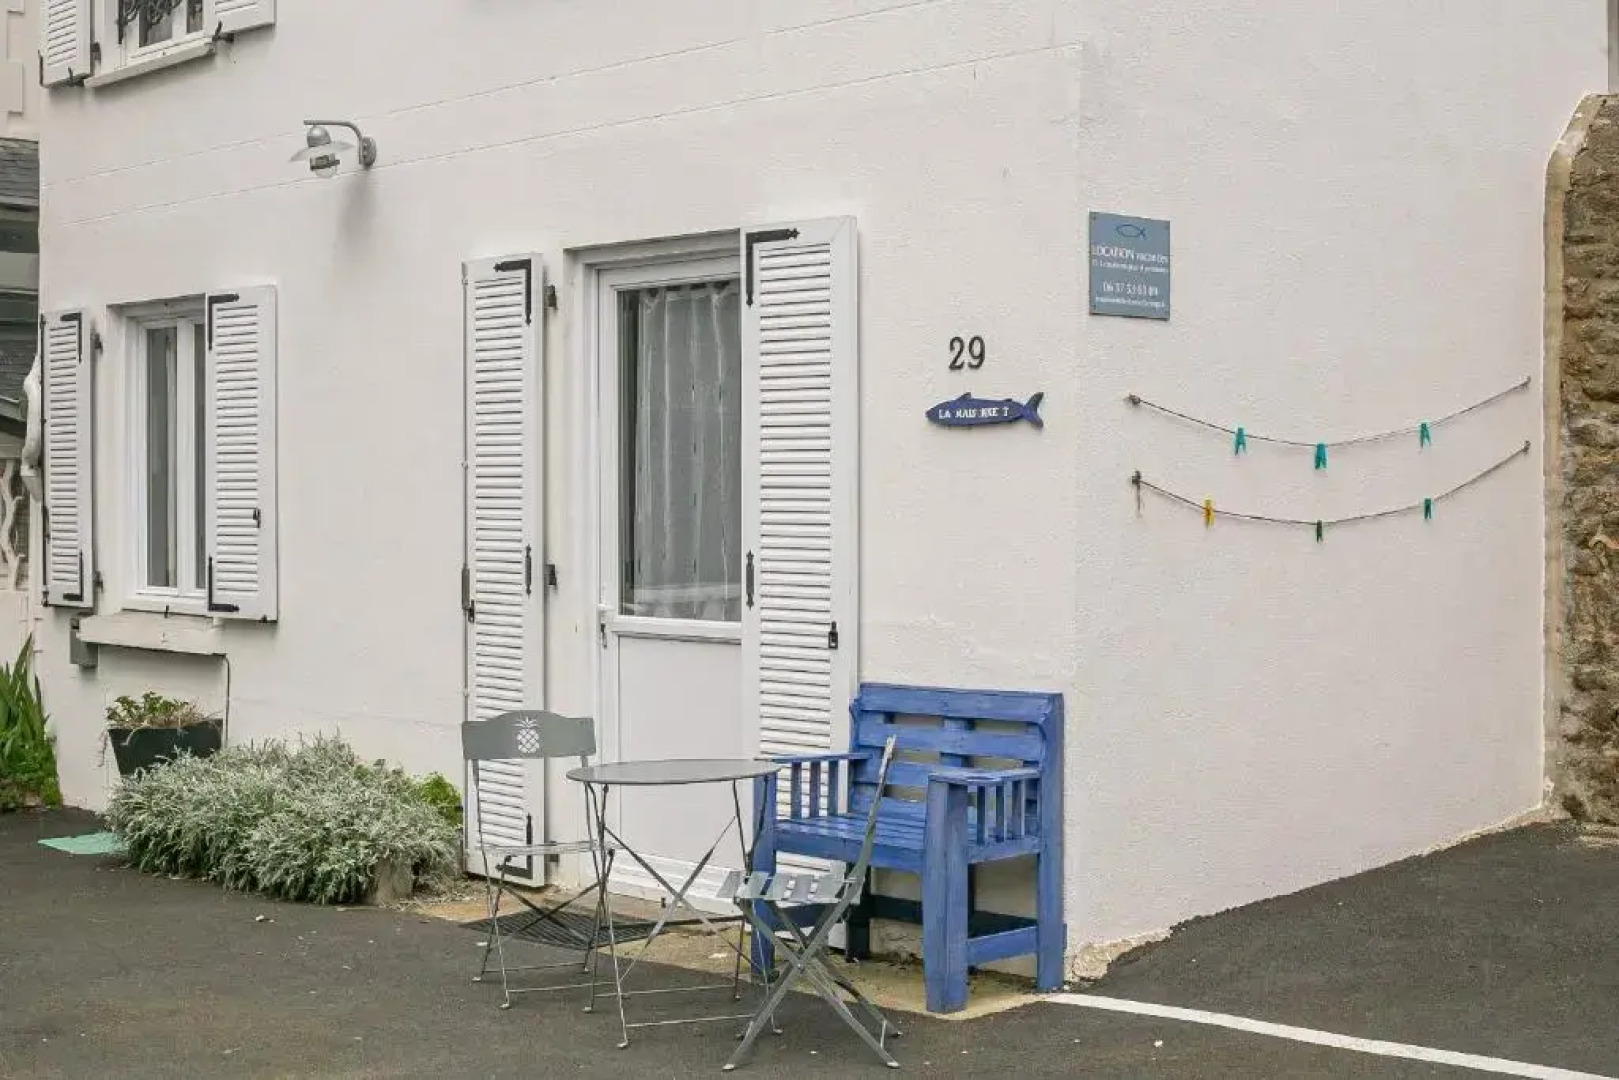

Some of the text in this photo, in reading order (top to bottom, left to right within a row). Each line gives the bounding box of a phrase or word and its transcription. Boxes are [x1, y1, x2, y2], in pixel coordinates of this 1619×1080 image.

[1091, 245, 1135, 261] LOCATION
[949, 335, 986, 371] 29
[938, 409, 951, 419] LA
